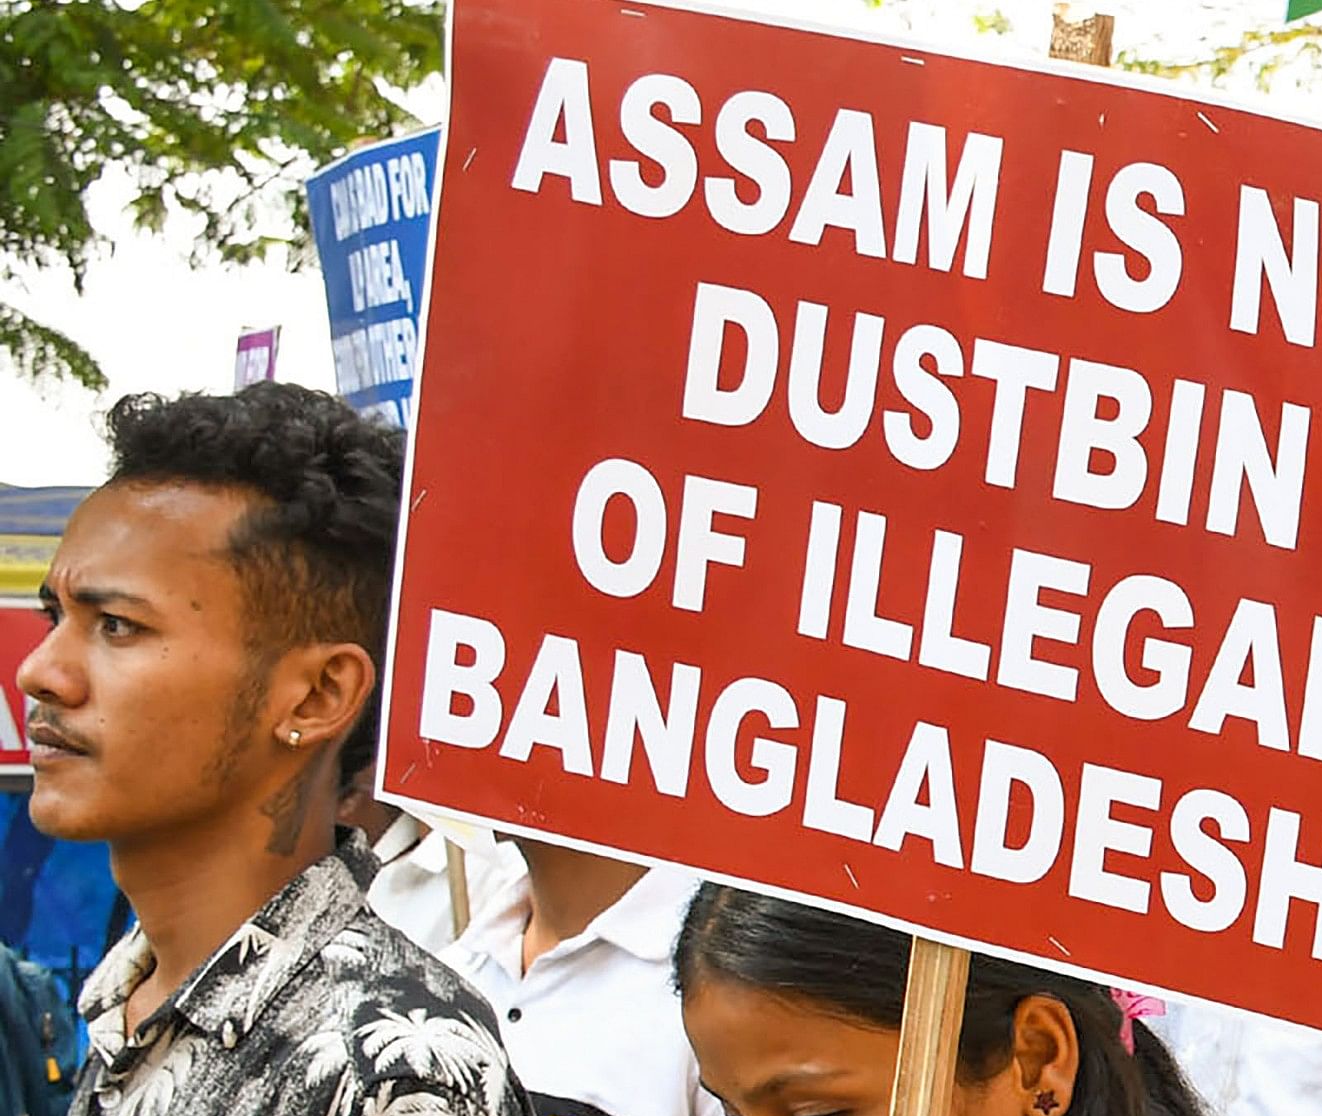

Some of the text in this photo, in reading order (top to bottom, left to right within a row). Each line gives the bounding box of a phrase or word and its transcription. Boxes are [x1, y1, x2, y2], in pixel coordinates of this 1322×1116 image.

[387, 151, 430, 221] FOR
[512, 57, 1003, 279] ASSAM
[1043, 150, 1184, 312] IS
[683, 282, 1310, 549] DUSTBIN
[573, 459, 757, 611] OF
